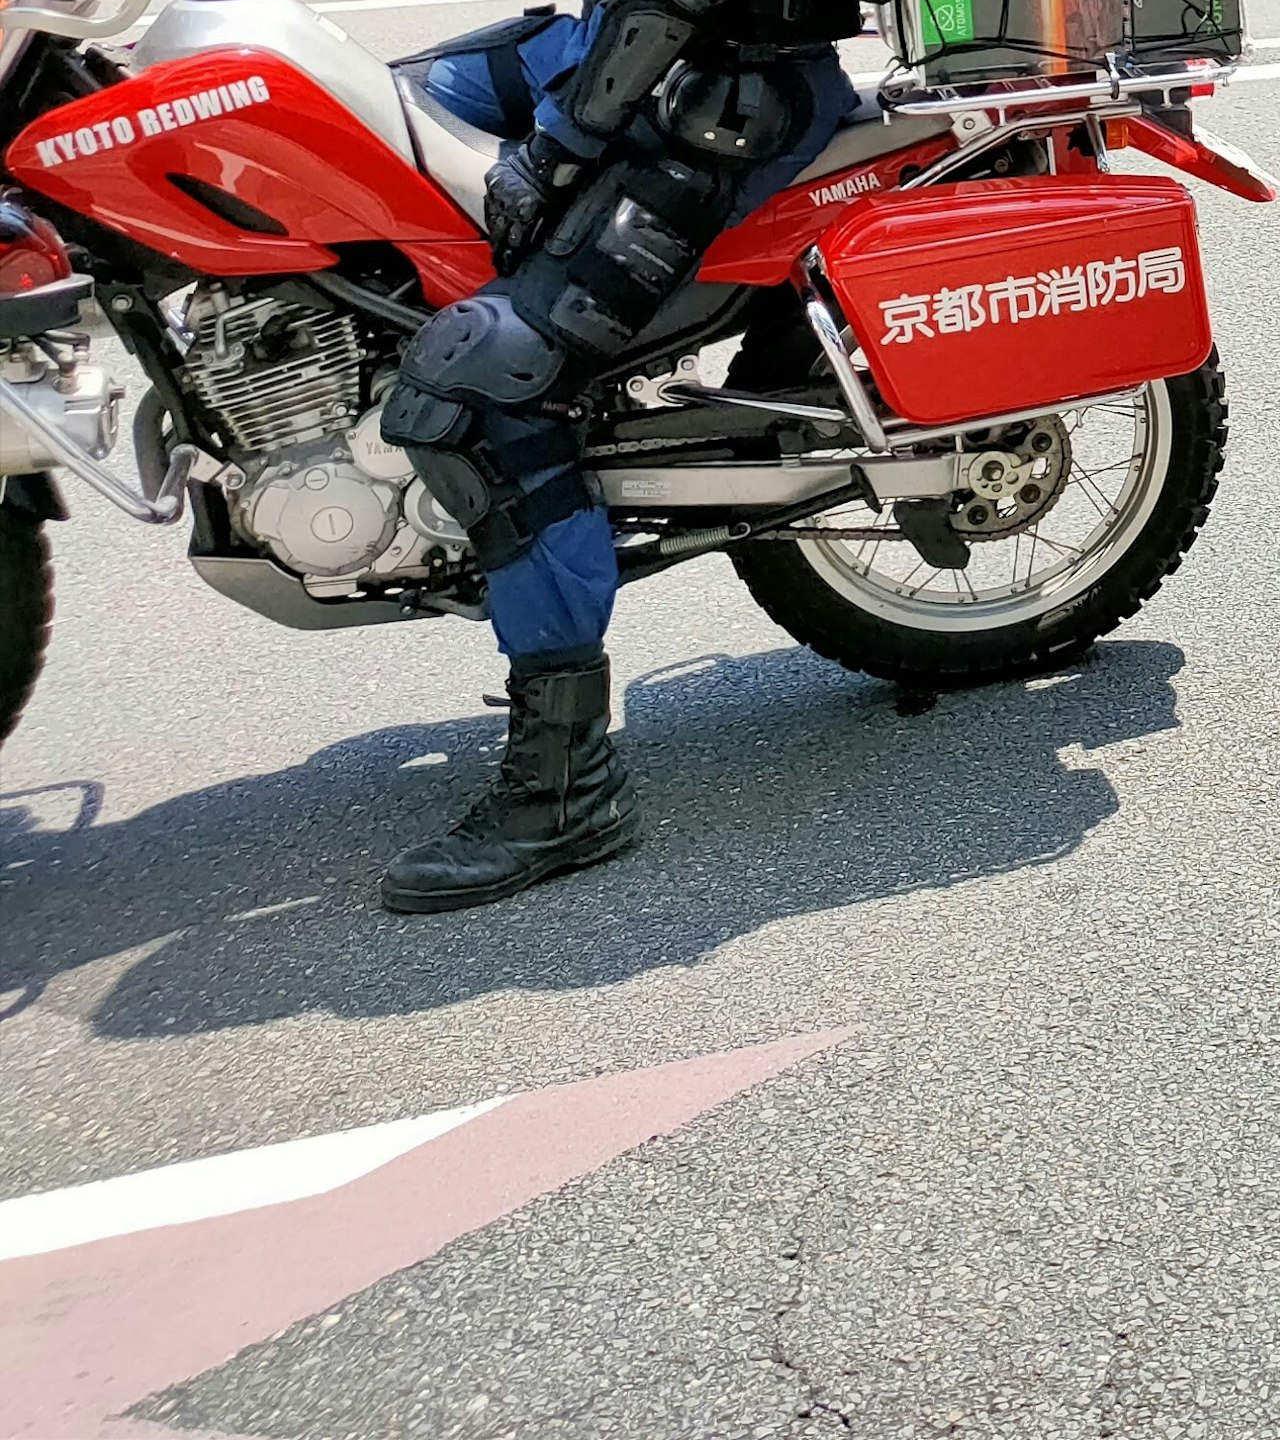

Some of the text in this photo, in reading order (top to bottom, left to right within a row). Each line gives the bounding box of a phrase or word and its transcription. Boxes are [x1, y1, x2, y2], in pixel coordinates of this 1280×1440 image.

[35, 76, 271, 168] KYOTO REDWING
[808, 172, 881, 207] YAMAHA
[878, 246, 1186, 346] 京都市消防局
